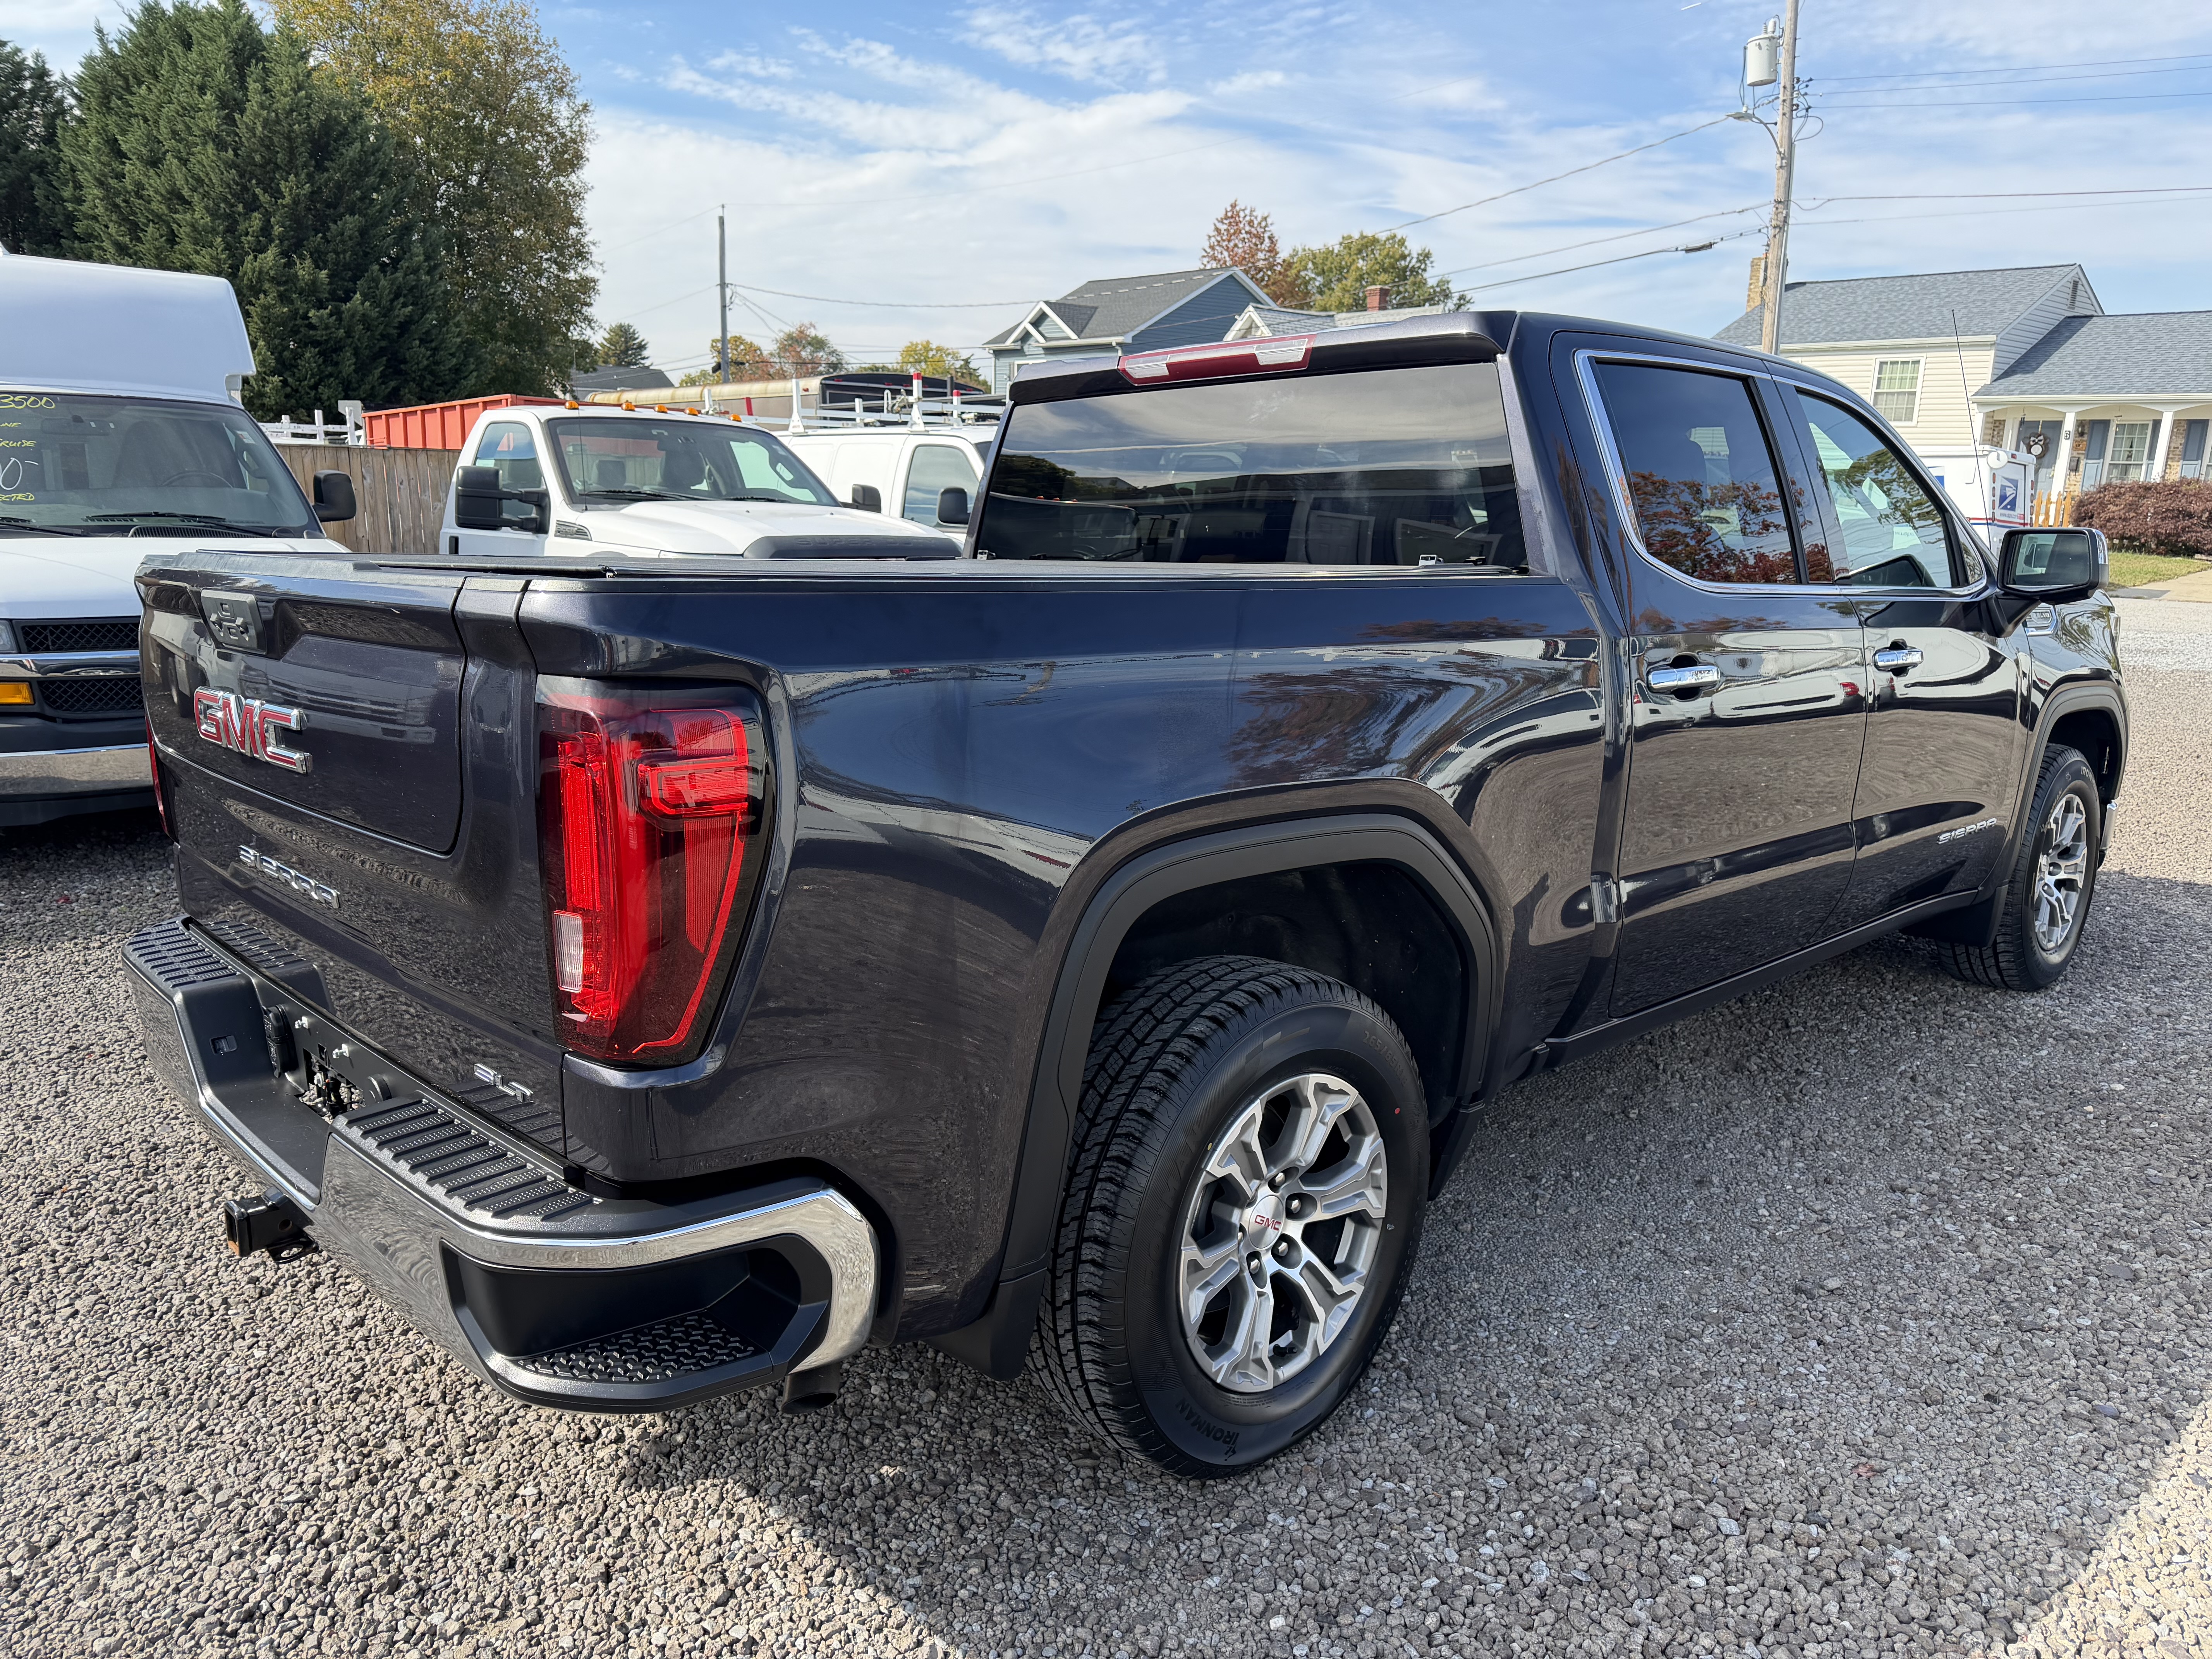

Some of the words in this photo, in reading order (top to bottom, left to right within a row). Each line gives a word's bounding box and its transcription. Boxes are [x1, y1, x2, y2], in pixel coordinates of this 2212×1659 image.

[795, 537, 876, 547] SUPER
[194, 686, 313, 774] GMC
[1936, 817, 1997, 845] SIERRA
[238, 844, 341, 909] SIERRA
[473, 1063, 534, 1103] SLT
[1254, 1214, 1281, 1231] GMC
[1175, 1397, 1240, 1446] IRONMAN
